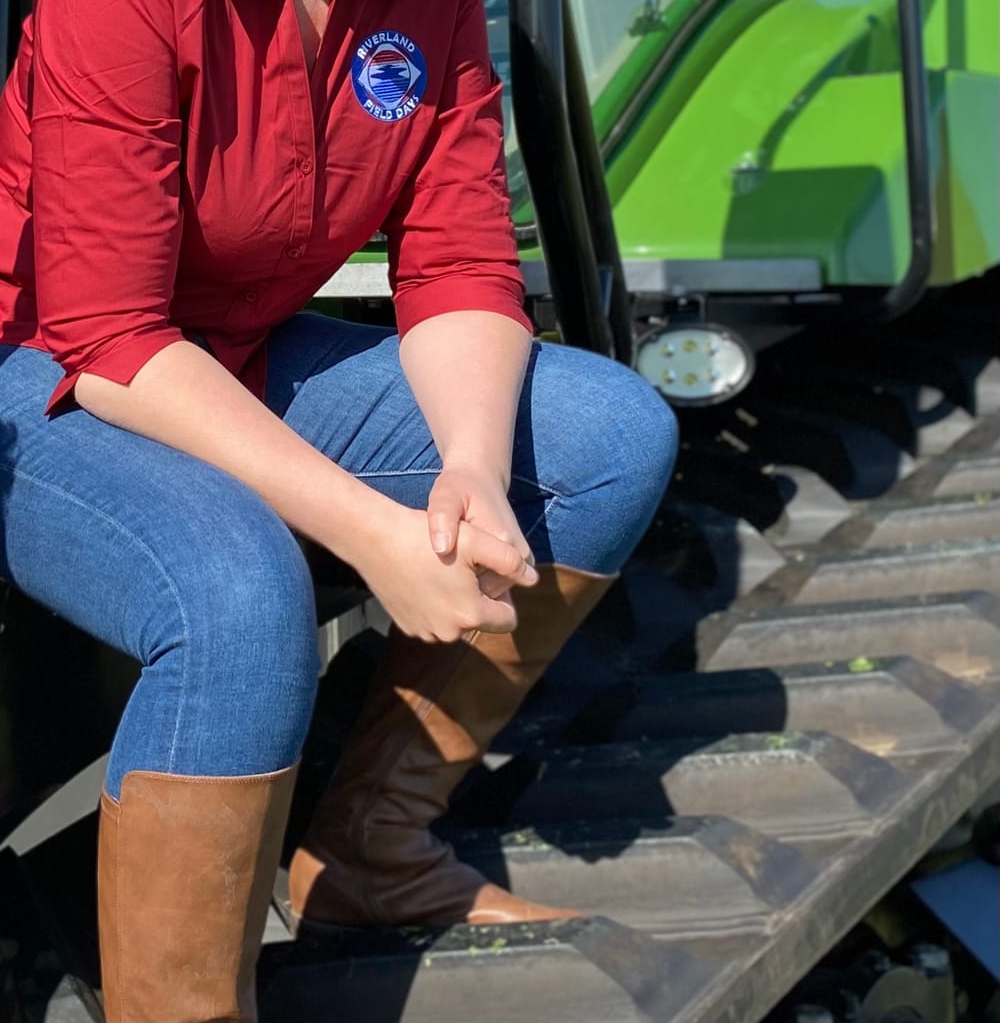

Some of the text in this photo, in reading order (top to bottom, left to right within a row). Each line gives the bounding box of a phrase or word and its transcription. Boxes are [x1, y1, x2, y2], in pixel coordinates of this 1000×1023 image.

[356, 32, 416, 60] RIVERLAND
[363, 95, 420, 120] FIELD DAYS
